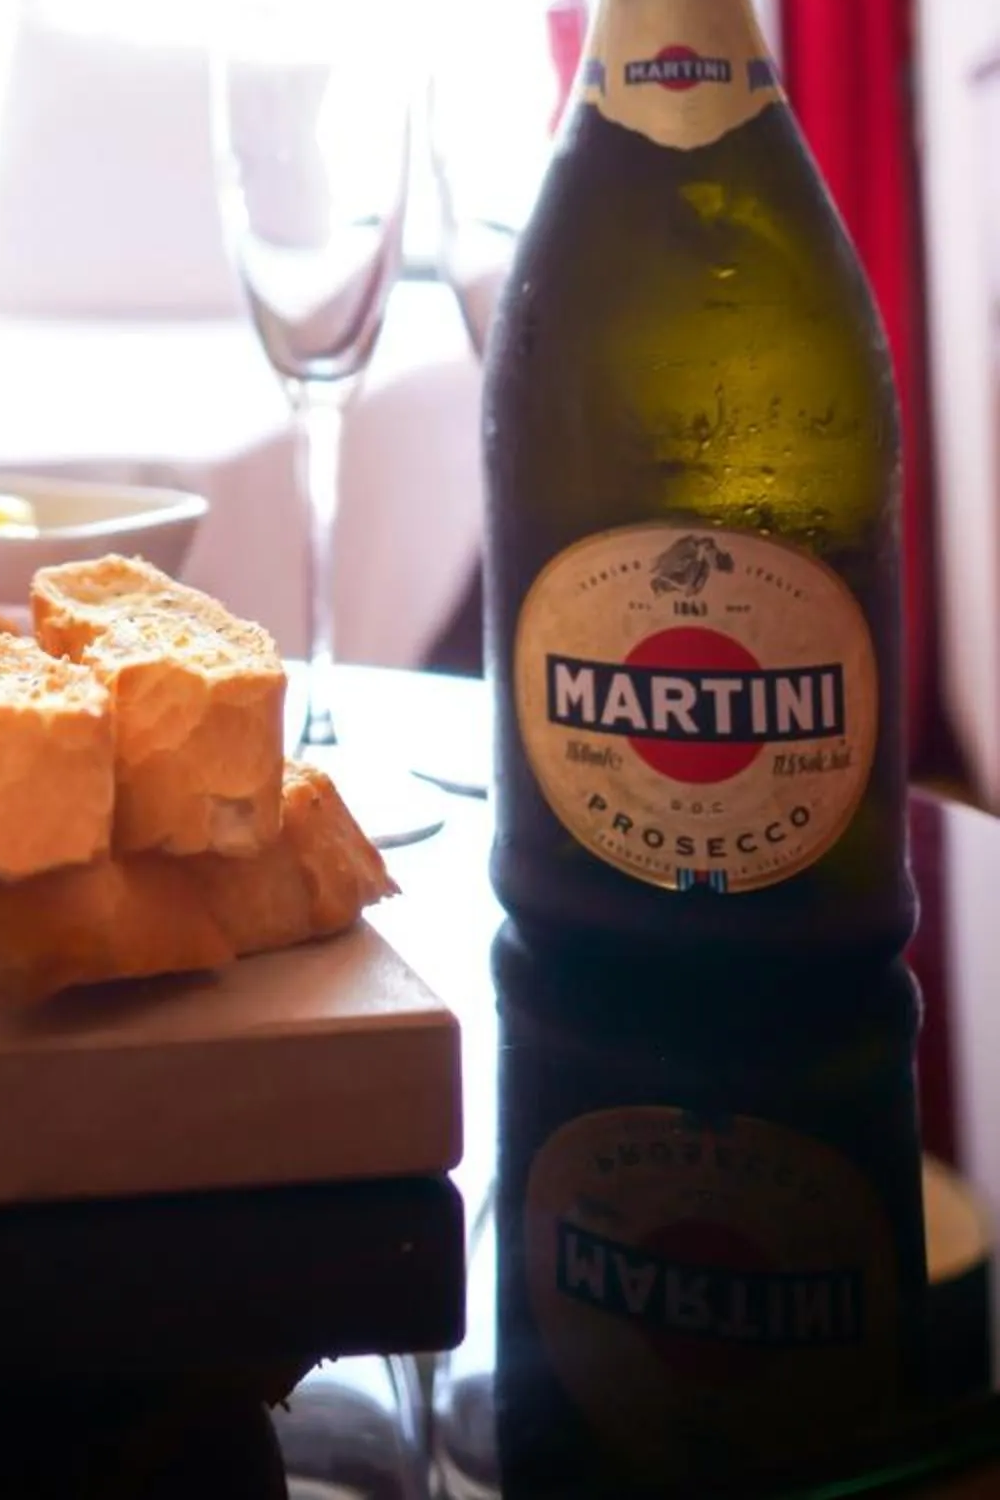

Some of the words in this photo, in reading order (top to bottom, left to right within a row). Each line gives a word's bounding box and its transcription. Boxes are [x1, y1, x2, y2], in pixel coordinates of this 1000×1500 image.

[629, 61, 728, 85] MARTINI
[553, 662, 835, 734] MARTINI
[587, 794, 811, 858] PROSECCO
